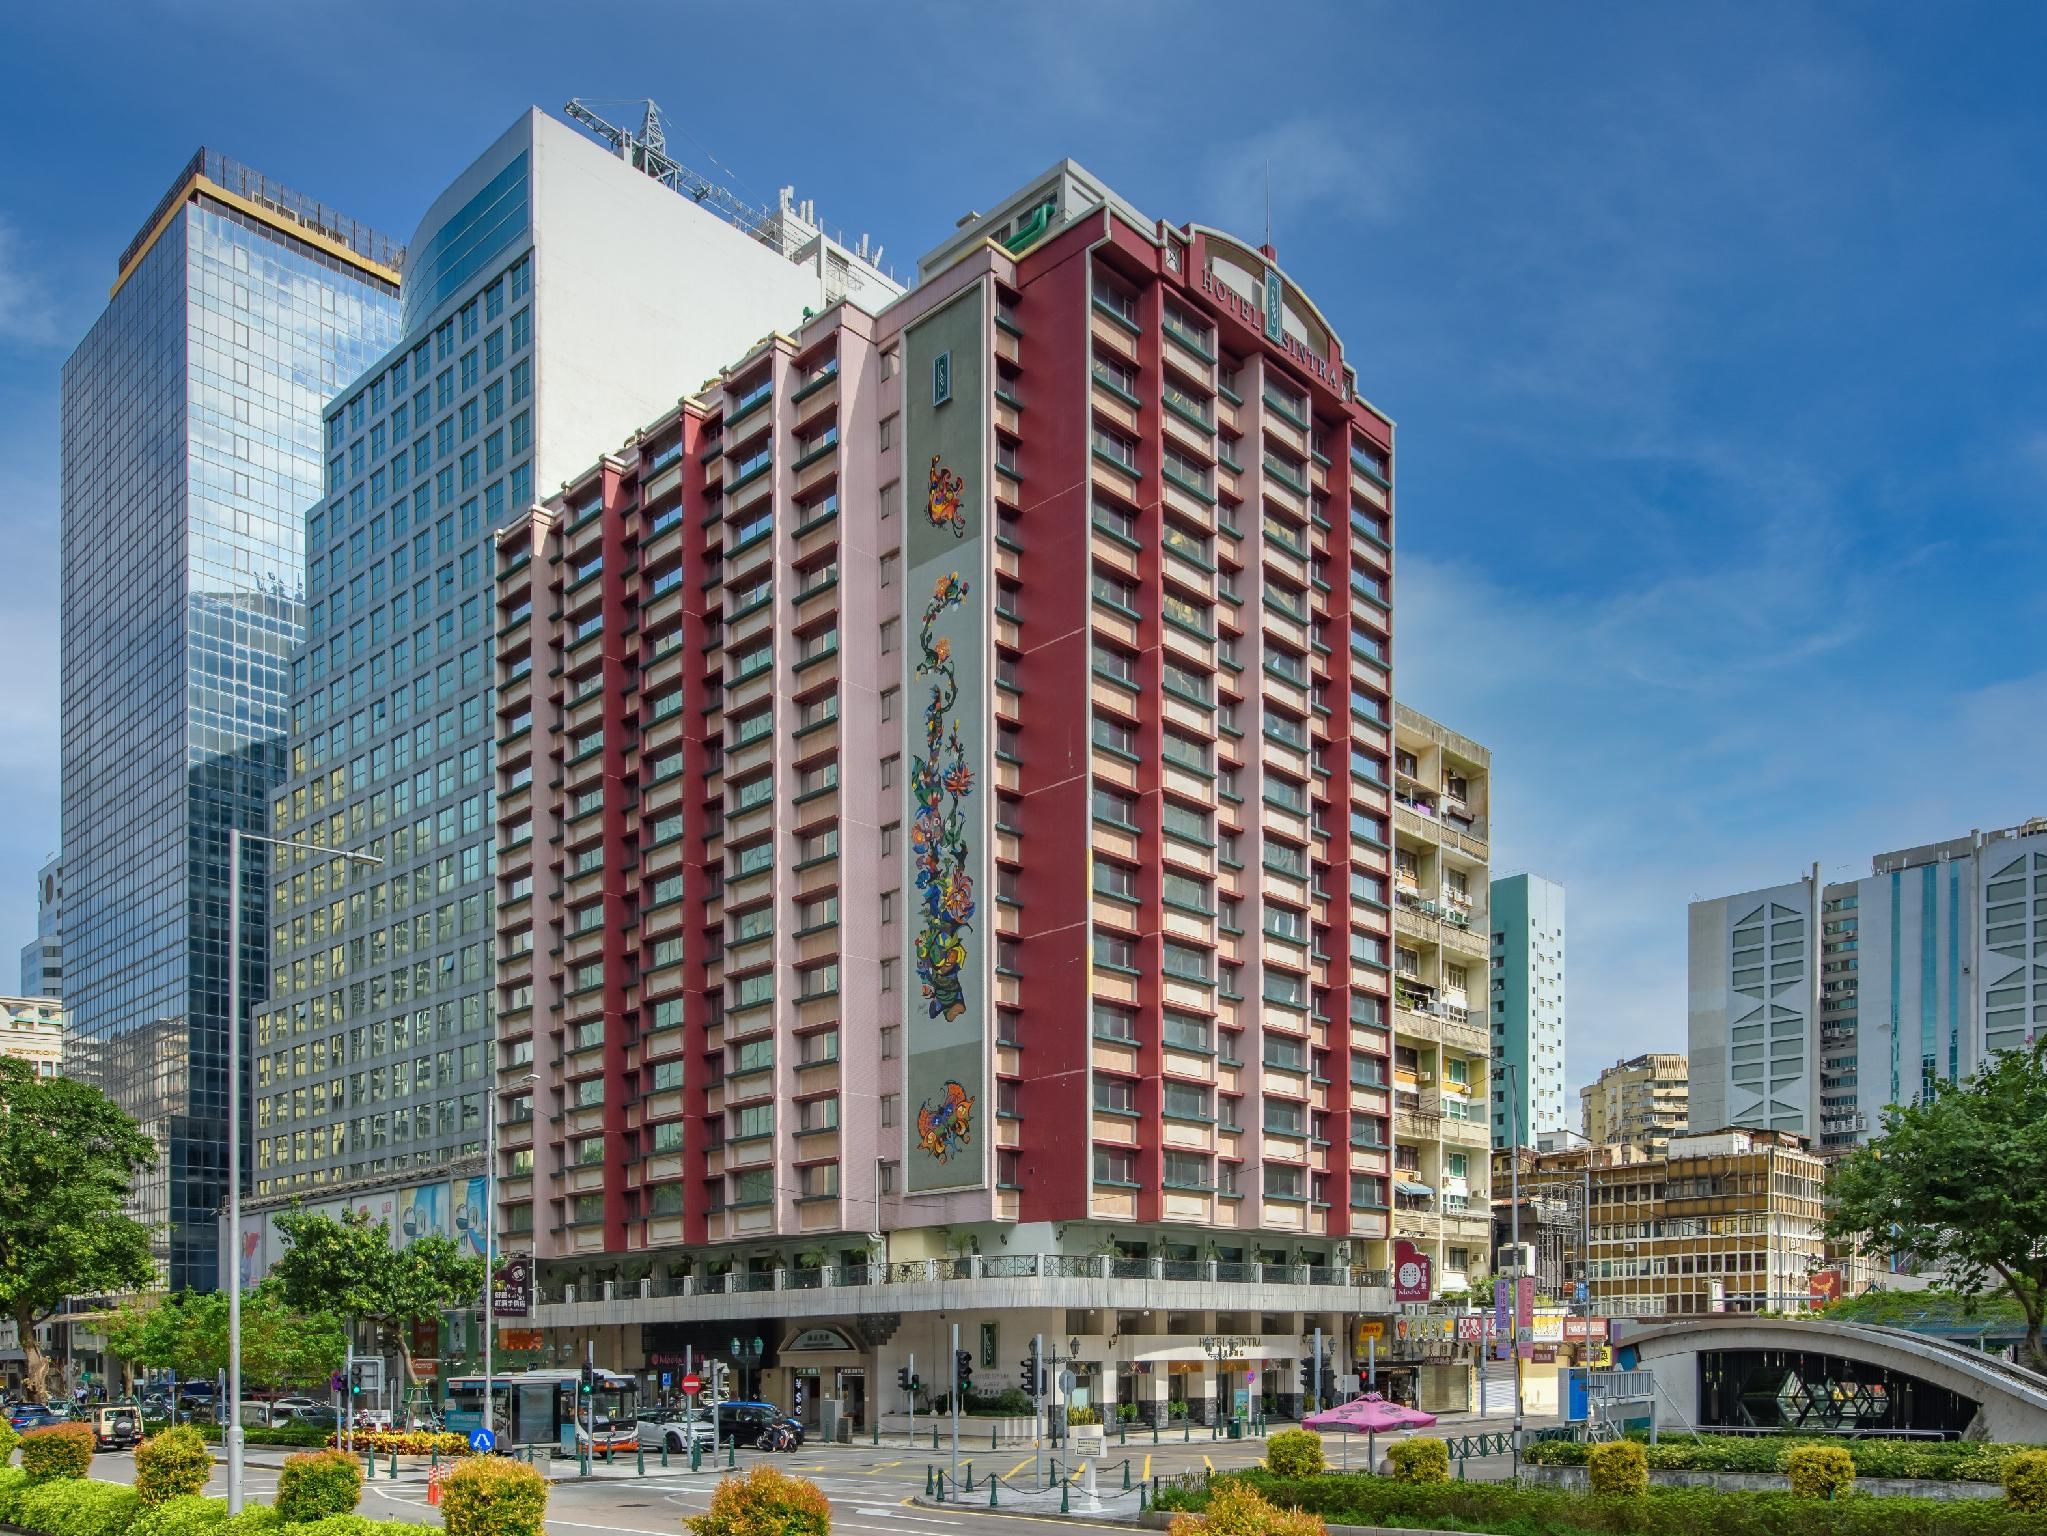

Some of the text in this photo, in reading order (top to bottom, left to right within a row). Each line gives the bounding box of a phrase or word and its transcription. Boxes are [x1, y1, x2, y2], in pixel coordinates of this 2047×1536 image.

[1202, 268, 1338, 388] HOTEL SINTRA
[1199, 1336, 1225, 1348] HTEL
